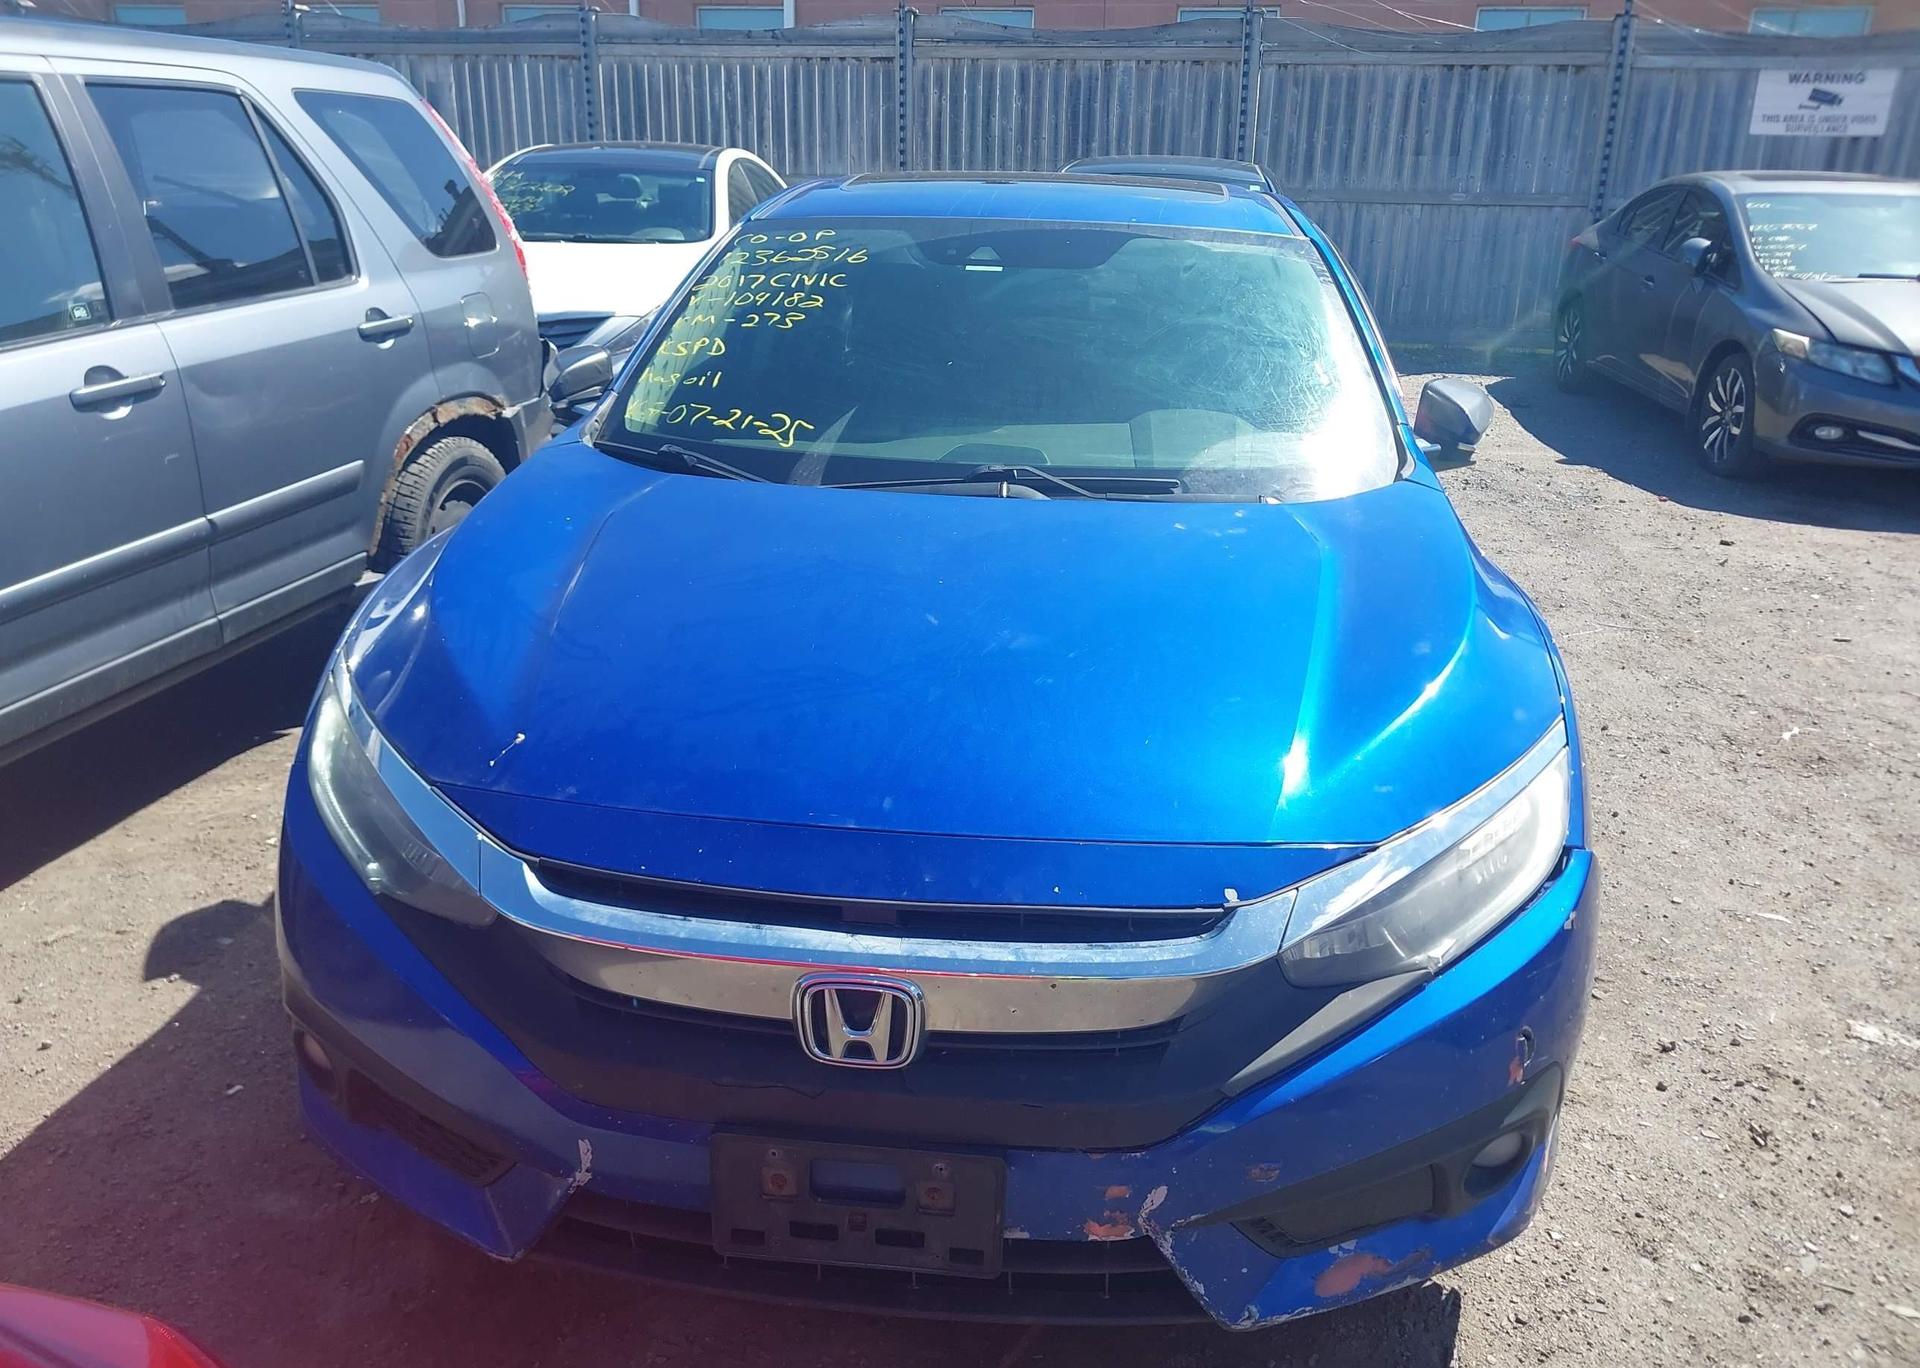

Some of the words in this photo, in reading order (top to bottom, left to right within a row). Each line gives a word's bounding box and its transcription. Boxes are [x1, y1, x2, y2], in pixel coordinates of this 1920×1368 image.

[1788, 72, 1866, 85] WARNING
[1761, 114, 1780, 123] THIS
[1783, 114, 1805, 123] AREA
[769, 272, 849, 289] CIVIC
